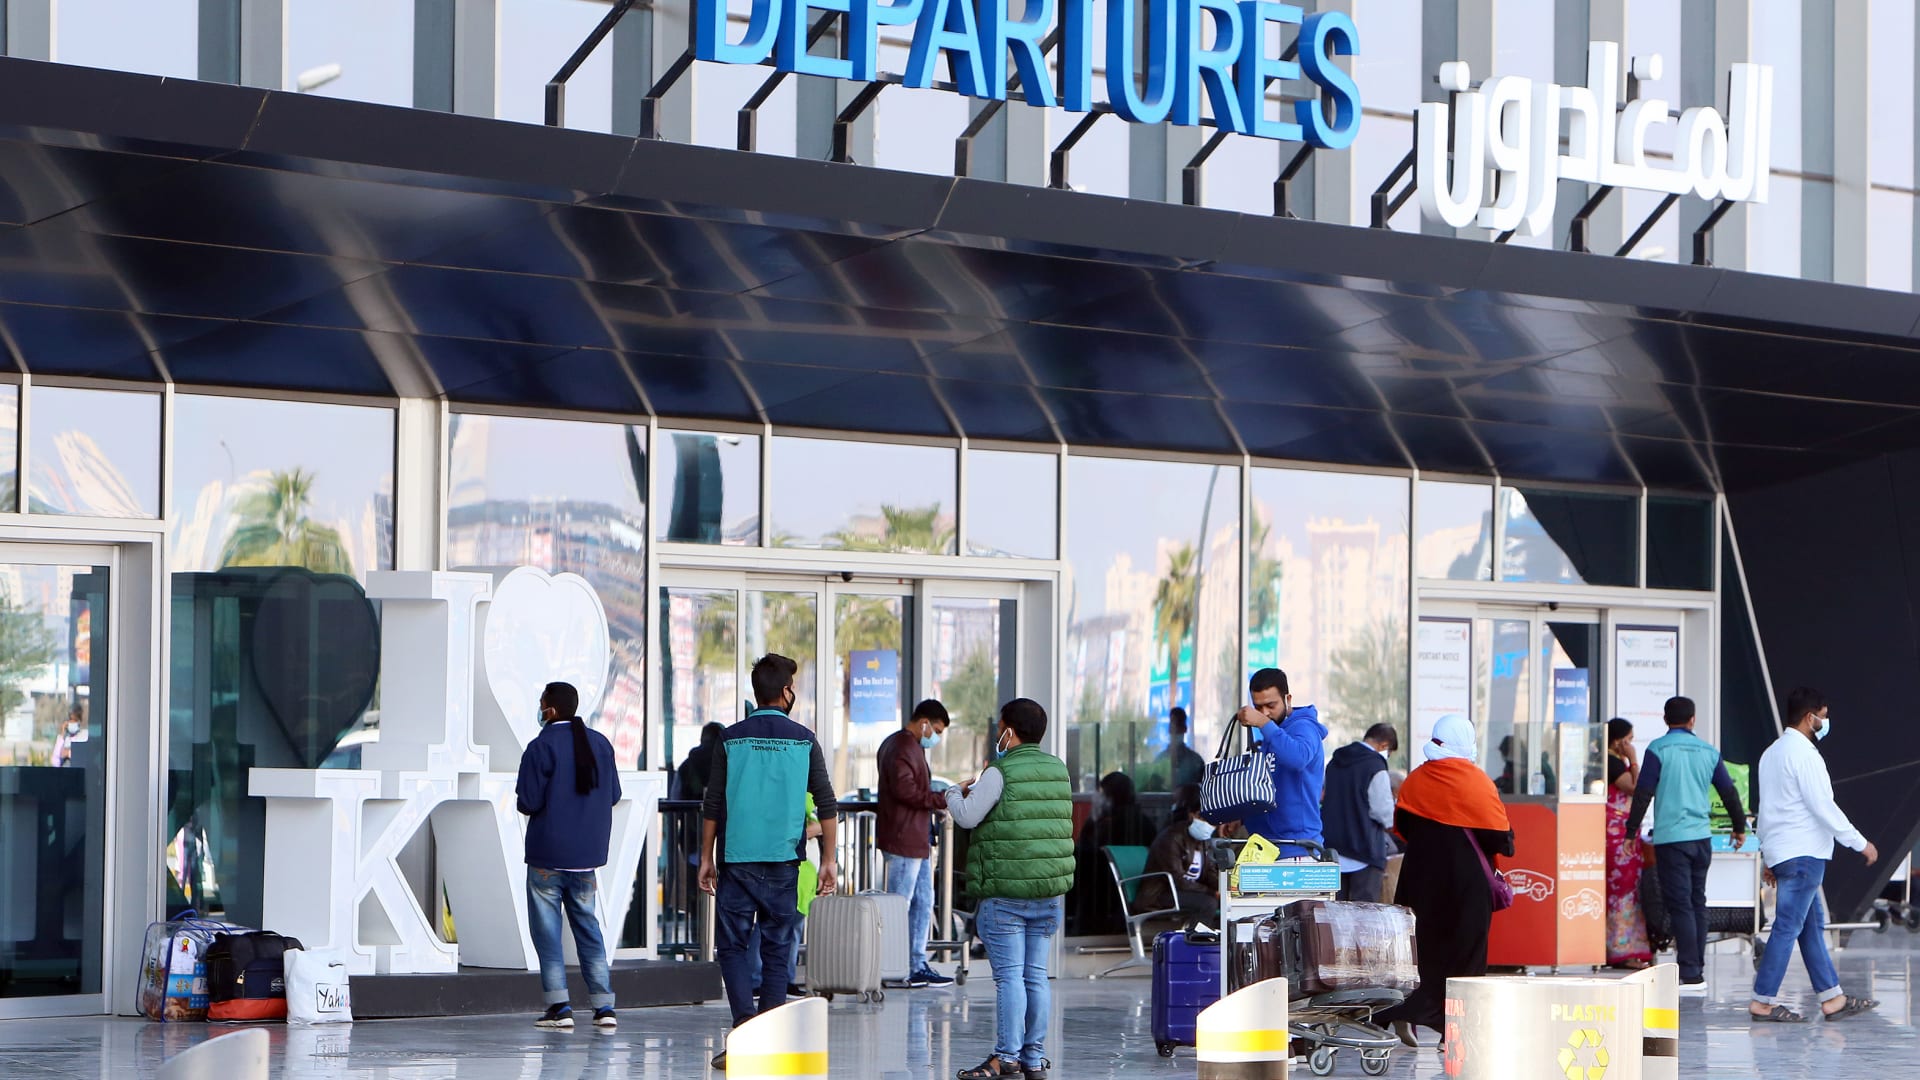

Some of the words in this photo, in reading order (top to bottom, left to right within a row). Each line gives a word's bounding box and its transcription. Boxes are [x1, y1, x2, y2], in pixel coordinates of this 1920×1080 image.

[1418, 41, 1773, 237] المغادرون
[1444, 998, 1465, 1017] TAL
[1550, 1003, 1617, 1022] PLASTIC
